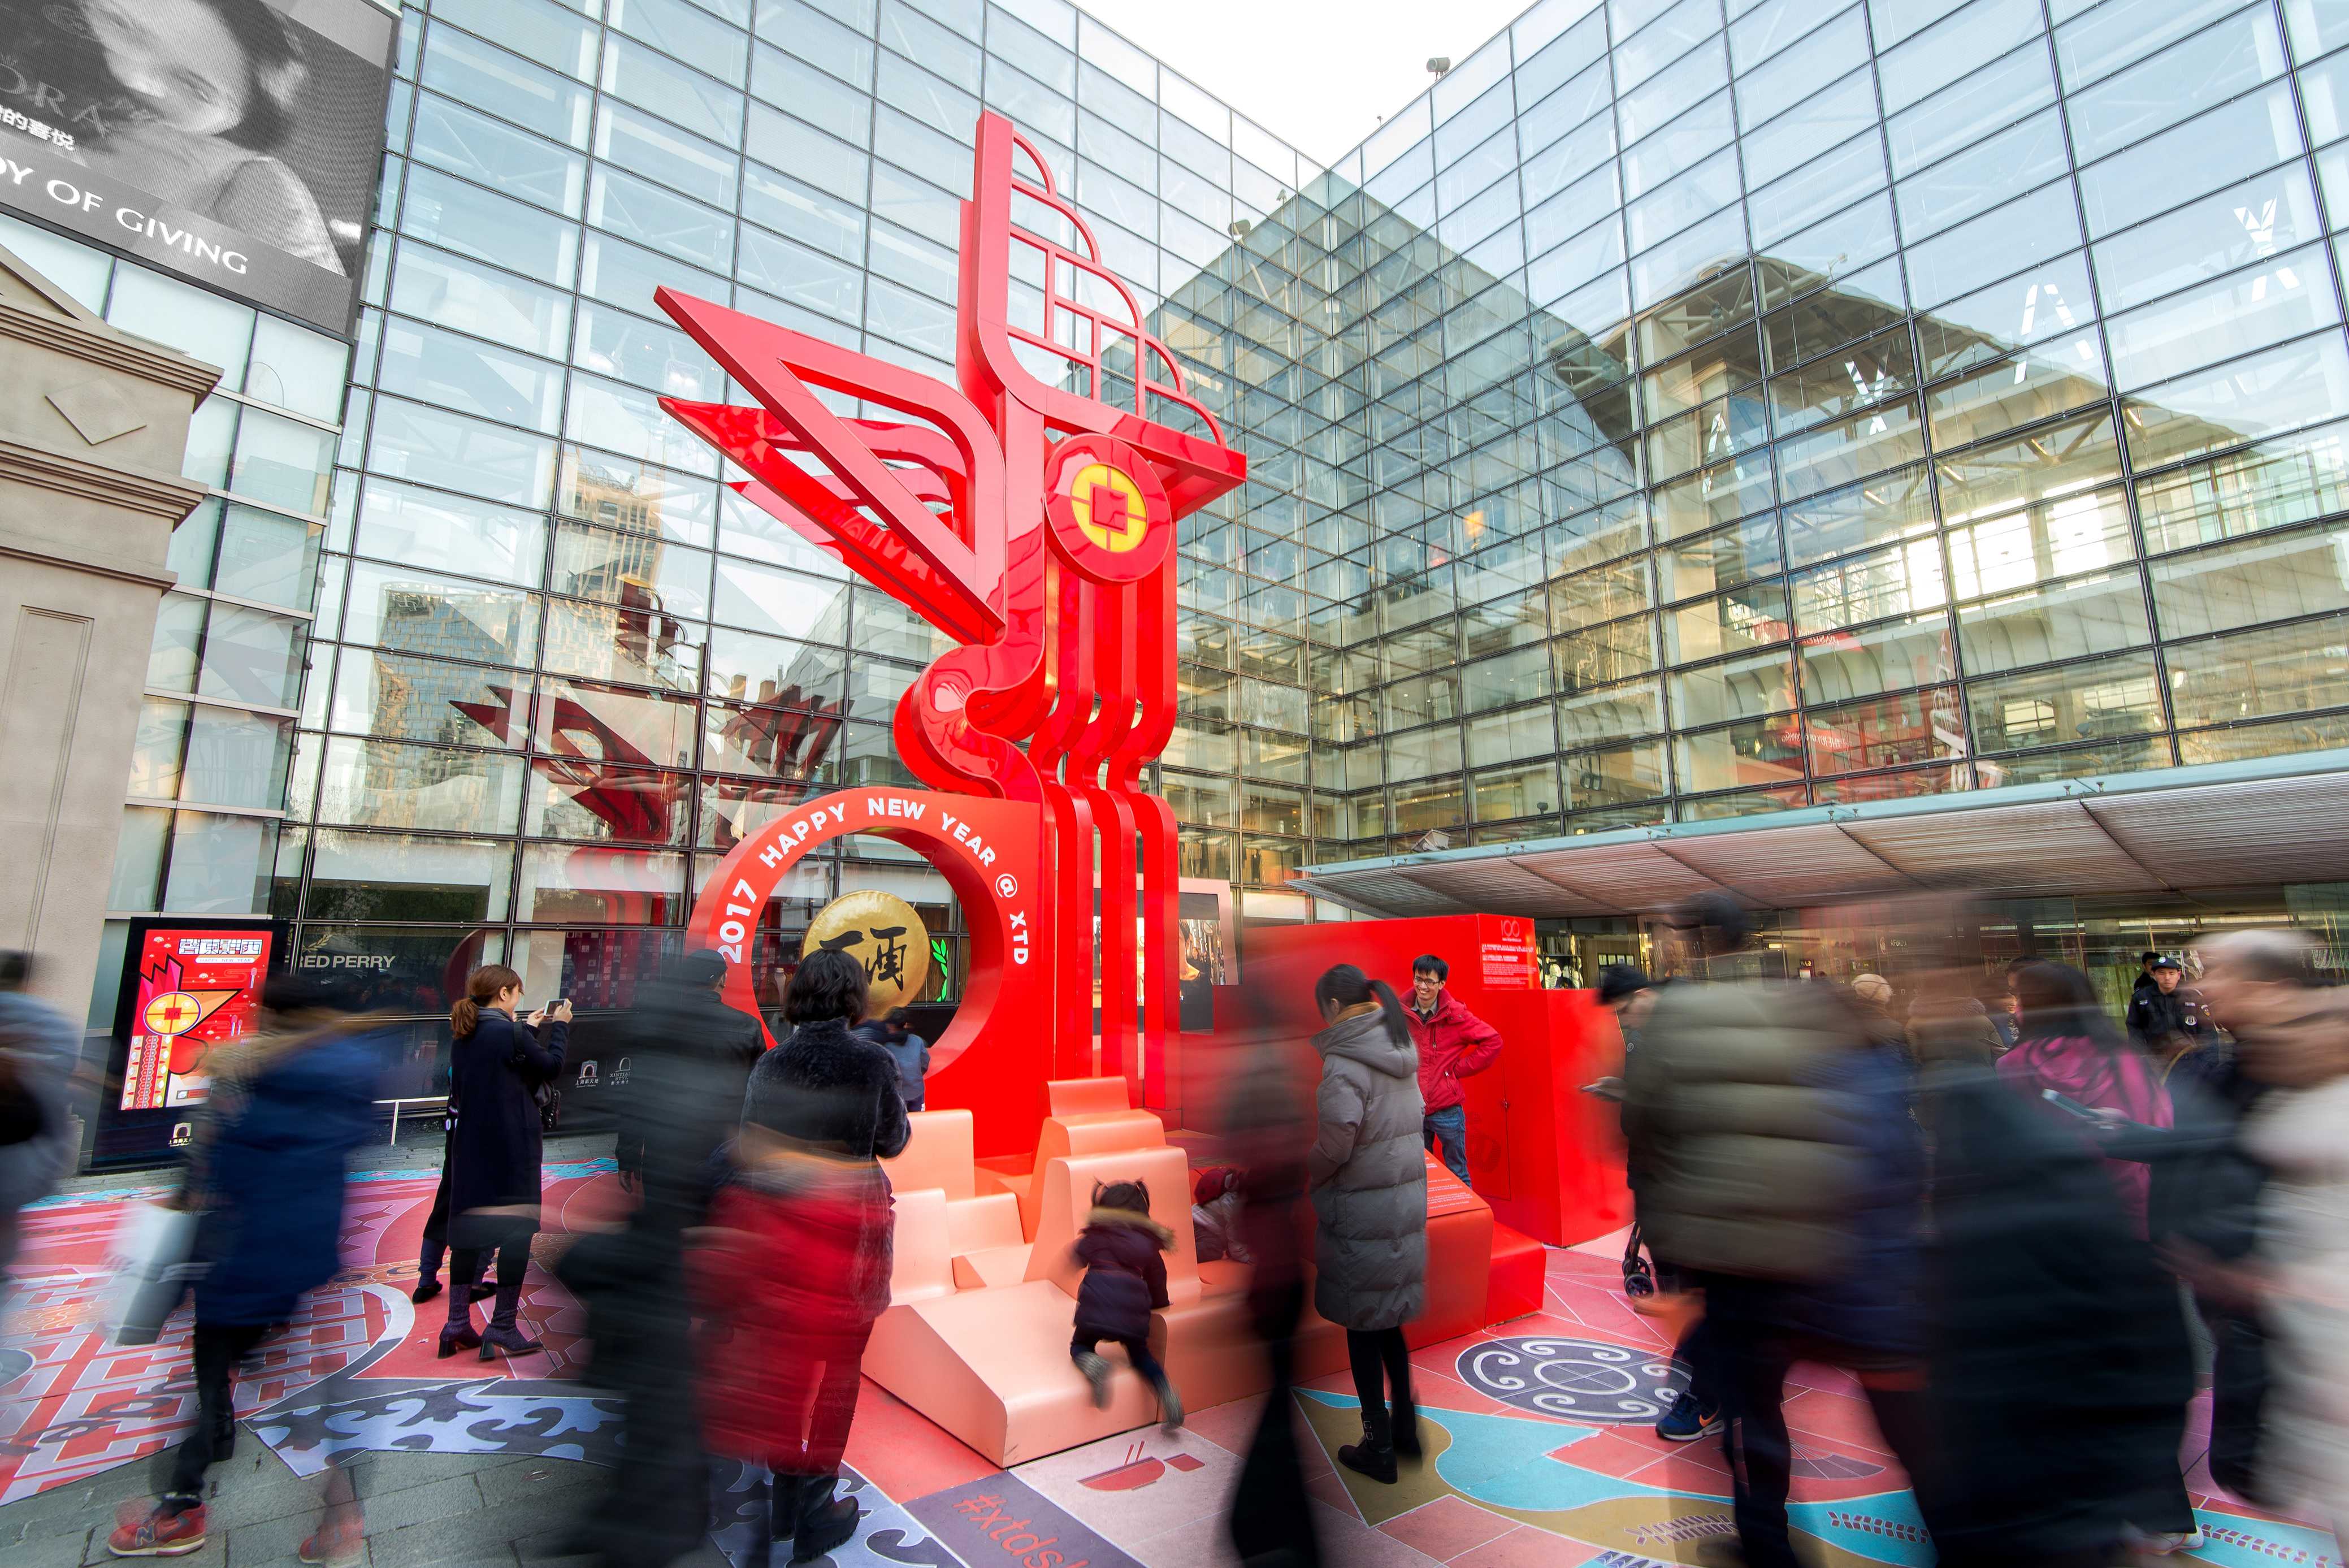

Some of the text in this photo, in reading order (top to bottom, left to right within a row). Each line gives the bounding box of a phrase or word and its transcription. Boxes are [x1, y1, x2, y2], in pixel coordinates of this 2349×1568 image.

[0, 104, 74, 151] 的喜悦
[0, 157, 249, 275] Y OF GIVING
[717, 798, 1029, 964] 2017 HAPPY NEW YEAR @ XTD
[332, 955, 396, 968] PERRY
